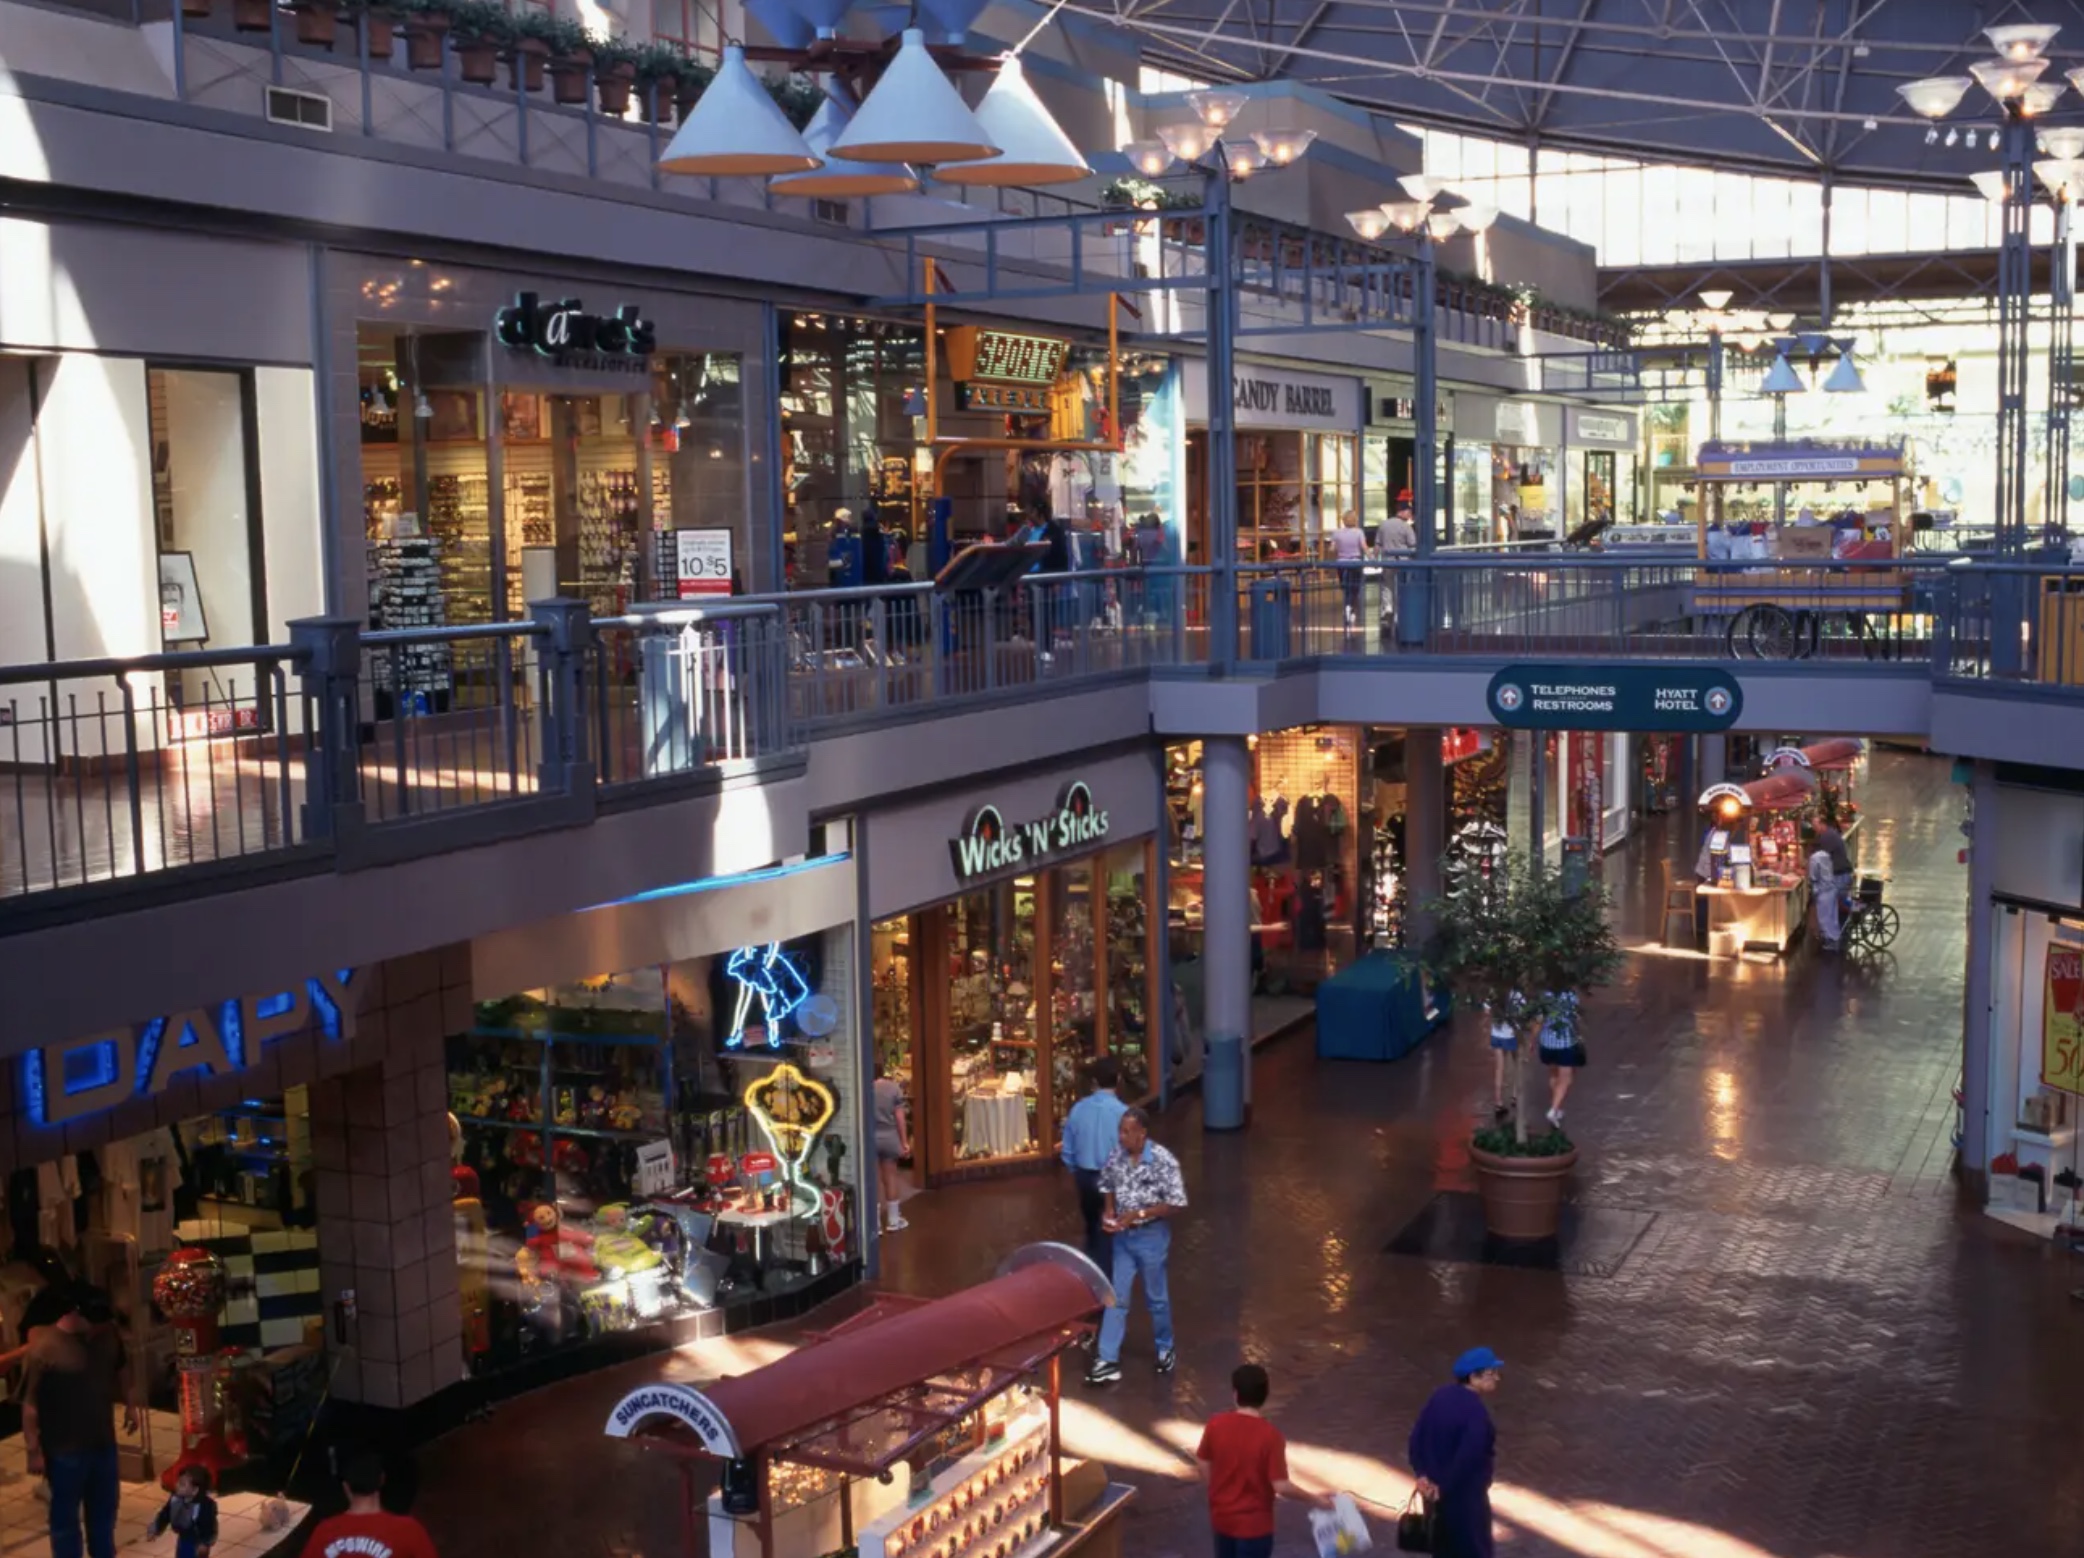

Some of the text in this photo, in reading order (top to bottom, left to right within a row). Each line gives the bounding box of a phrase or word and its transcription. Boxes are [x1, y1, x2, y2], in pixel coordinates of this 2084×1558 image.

[975, 333, 1062, 380] SPORTS
[1233, 376, 1336, 416] ANDY BARREL
[1734, 458, 1854, 474] EMPLOYMENT OPPORTUNITIES
[681, 556, 703, 576] 10
[1530, 684, 1616, 697] TELEPHONES
[1655, 688, 1699, 700] HYATT
[1533, 699, 1613, 712] RESTROOMS
[1654, 699, 1699, 711] HOTEL
[959, 827, 1022, 877] Wicks
[1057, 803, 1109, 848] Sticks
[2052, 959, 2081, 980] SALE
[24, 967, 366, 1126] DAPY
[616, 1392, 719, 1442] SUNCATCHERS
